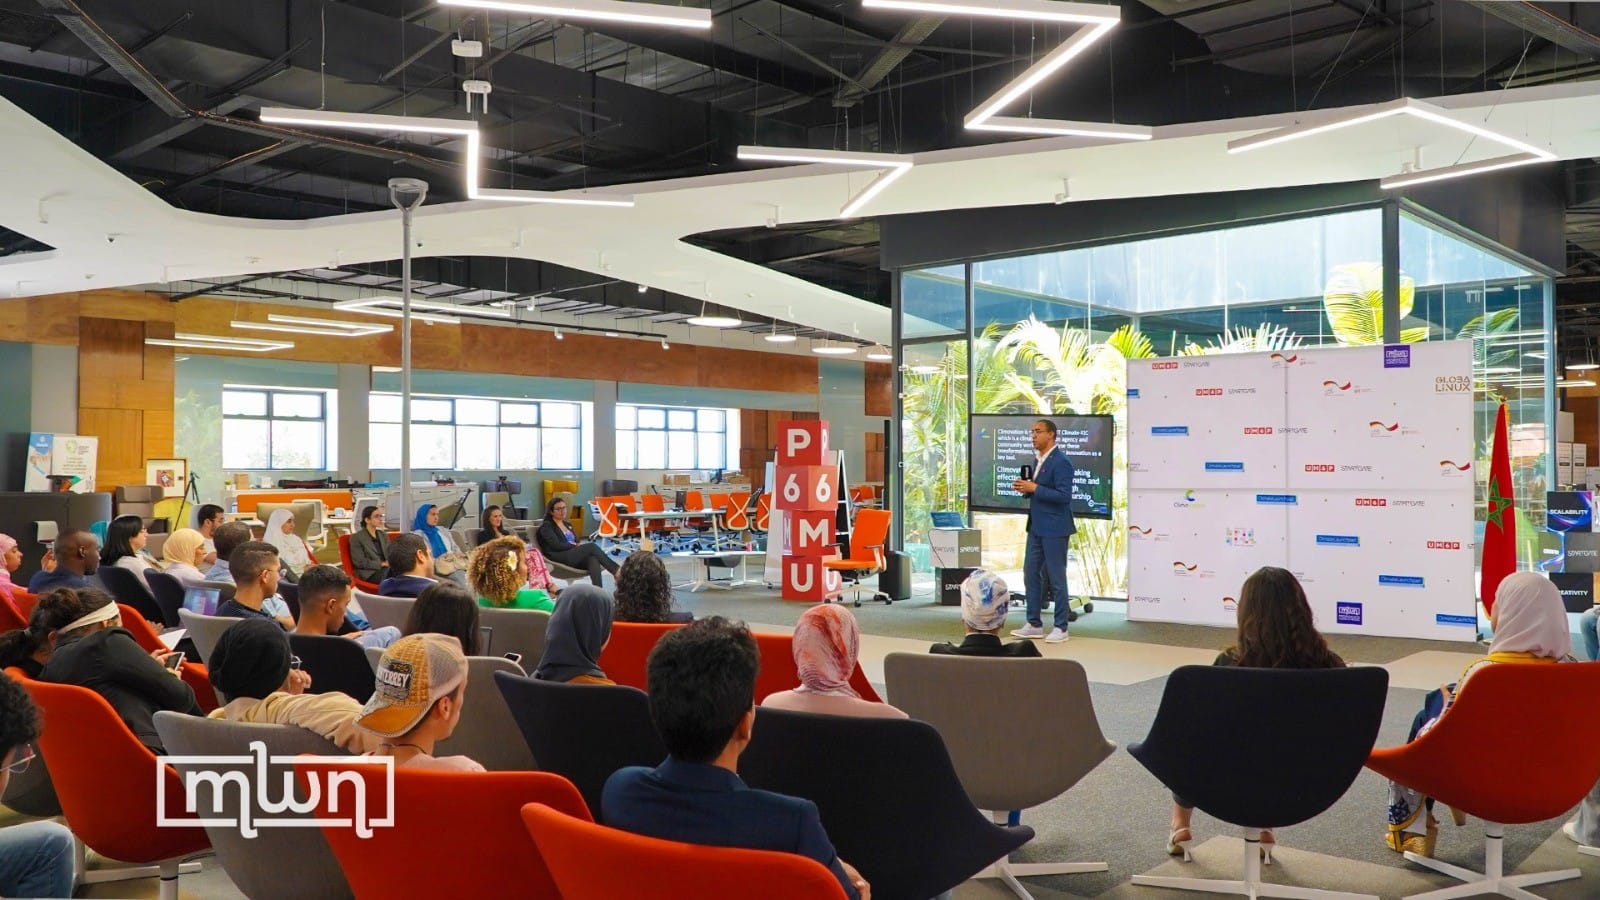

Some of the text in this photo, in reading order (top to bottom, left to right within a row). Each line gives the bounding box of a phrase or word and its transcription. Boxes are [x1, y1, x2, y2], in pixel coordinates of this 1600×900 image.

[1435, 384, 1470, 392] LINUX
[787, 428, 811, 457] P
[783, 473, 801, 503] 6
[815, 473, 831, 503] 6
[1074, 469, 1091, 478] aking
[799, 518, 830, 548] M
[1427, 541, 1460, 549] UM6P
[790, 562, 813, 593] U
